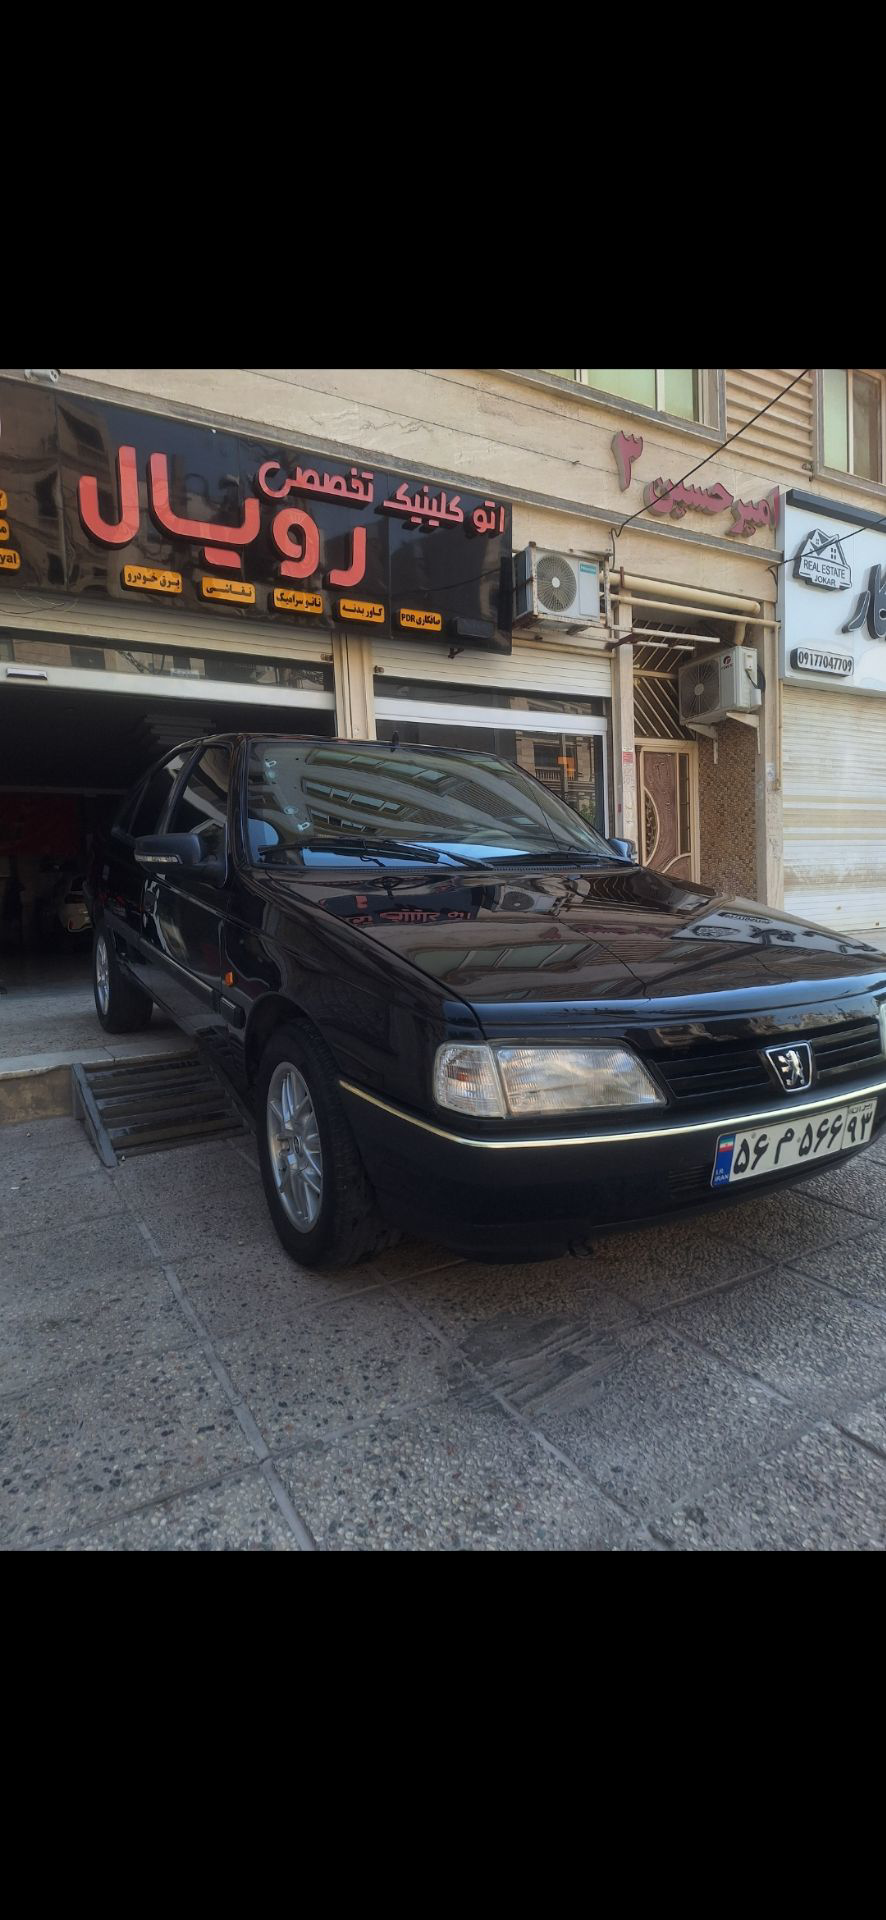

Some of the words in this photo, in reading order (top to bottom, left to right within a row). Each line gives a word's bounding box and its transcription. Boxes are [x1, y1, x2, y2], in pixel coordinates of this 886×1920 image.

[612, 430, 644, 492] ۳
[258, 461, 374, 503] تخصصی
[383, 482, 464, 527] کلینیک
[78, 445, 367, 587] رویال
[472, 500, 505, 534] اتو
[0, 553, 17, 565] yal
[803, 559, 822, 573] REAL
[822, 565, 846, 580] ESTATE
[127, 572, 158, 584] خودرو
[159, 575, 180, 589] برق
[814, 574, 836, 587] JOKAR
[367, 607, 383, 618] کاور
[401, 612, 416, 623] PDR
[415, 614, 441, 626] صافکاری
[798, 650, 853, 672] 09177047709
[733, 1133, 770, 1175] ۵۶
[798, 1114, 843, 1157] ۵۶۶
[847, 1111, 873, 1144] ۹۳
